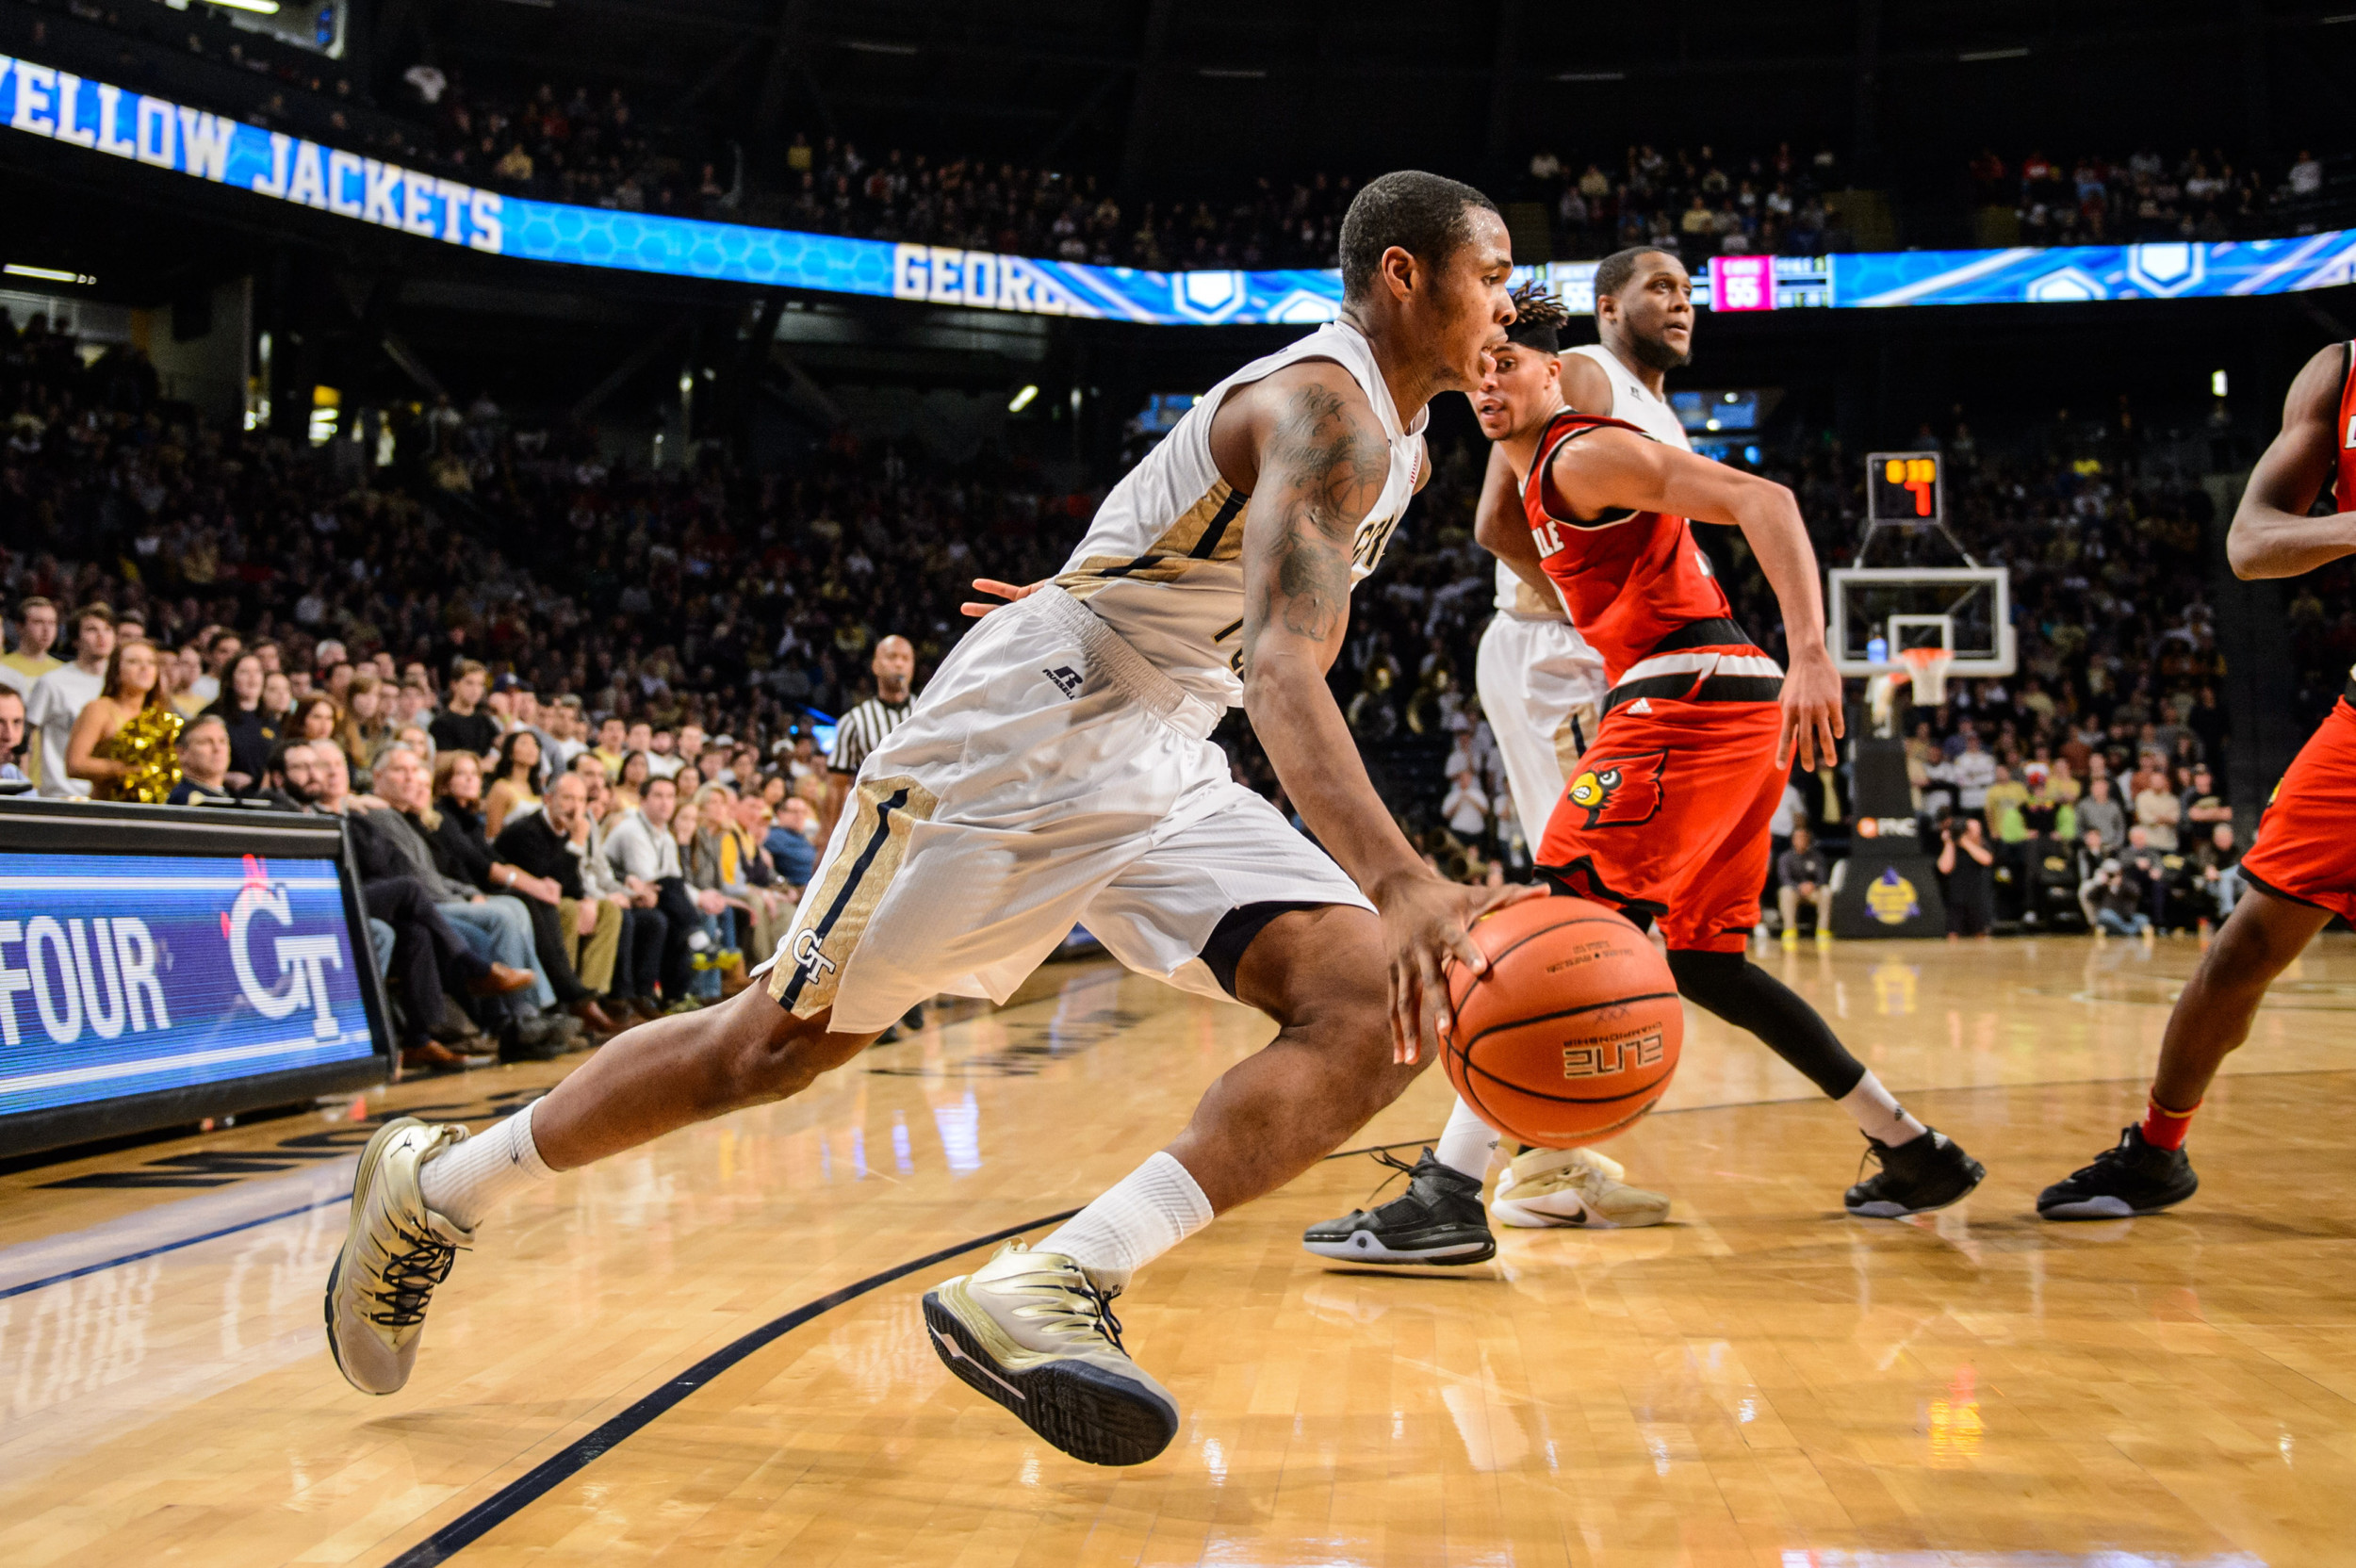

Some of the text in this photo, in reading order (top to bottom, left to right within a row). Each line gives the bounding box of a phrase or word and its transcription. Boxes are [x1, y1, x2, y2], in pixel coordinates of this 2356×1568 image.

[252, 131, 503, 254] JACKETS
[1726, 276, 1759, 308] 55
[1042, 668, 1075, 700] RUSSELL
[0, 915, 172, 1046] FOUR
[229, 882, 343, 1043] GT
[793, 928, 837, 985] GT
[1562, 1031, 1663, 1080] ELITE
